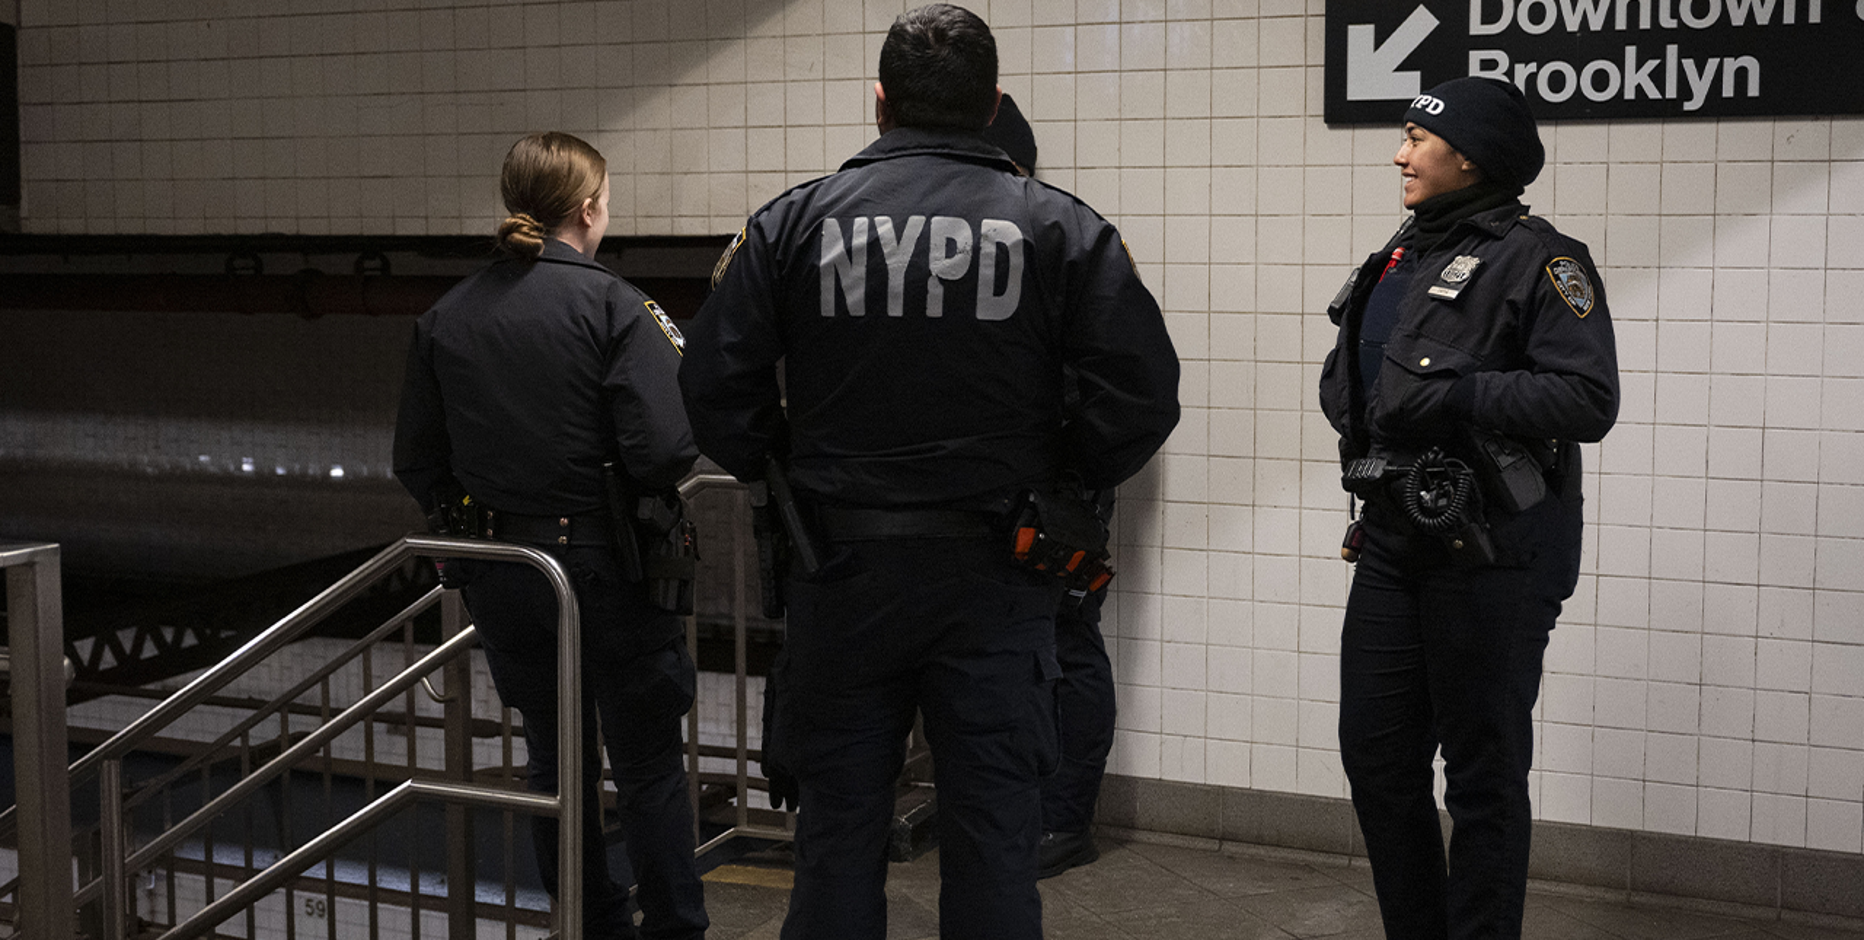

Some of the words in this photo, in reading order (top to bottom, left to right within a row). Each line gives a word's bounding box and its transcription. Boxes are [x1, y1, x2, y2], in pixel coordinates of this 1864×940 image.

[1469, 0, 1822, 36] Downtown
[1469, 44, 1760, 111] Brooklyn
[1410, 94, 1445, 115] YPD
[820, 215, 1024, 321] NYPD
[305, 898, 326, 919] 59
